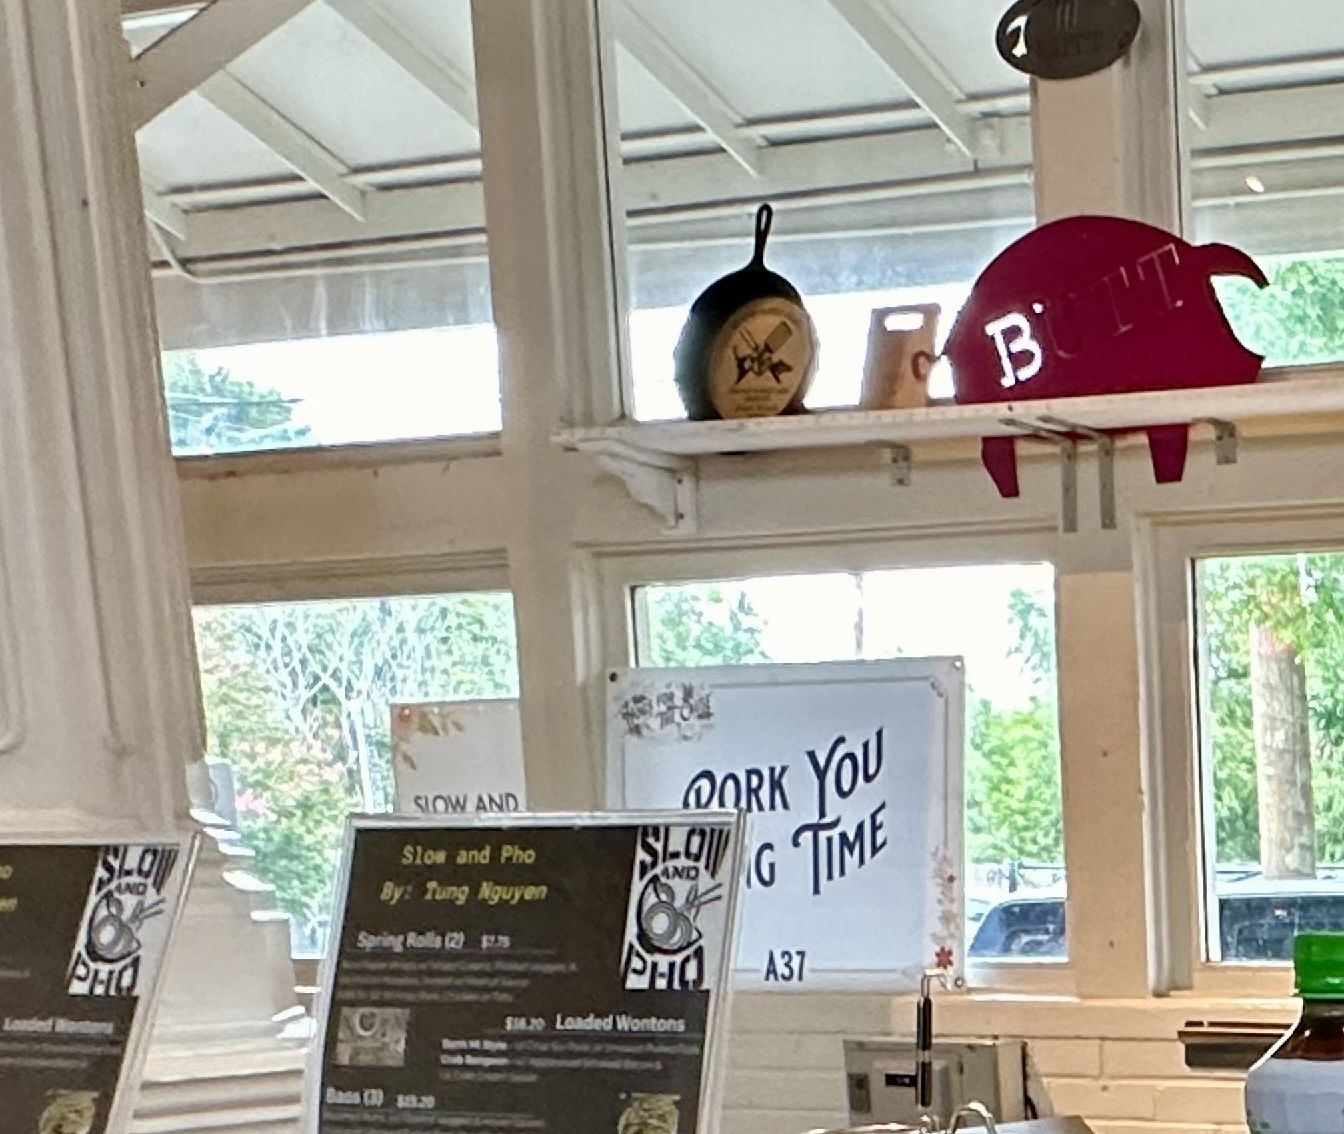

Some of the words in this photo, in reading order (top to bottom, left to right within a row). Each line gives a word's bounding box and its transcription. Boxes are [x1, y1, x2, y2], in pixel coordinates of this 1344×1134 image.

[806, 726, 884, 821] YOU
[402, 845, 448, 866] Slow
[455, 845, 493, 866] and
[501, 844, 536, 865] Pho
[792, 801, 888, 896] TIME
[660, 866, 699, 880] AND
[357, 931, 404, 953] Spring
[406, 931, 442, 949] Rolls
[765, 950, 807, 982] A37
[556, 1013, 613, 1031] Loaded
[615, 1014, 686, 1032] Wontons
